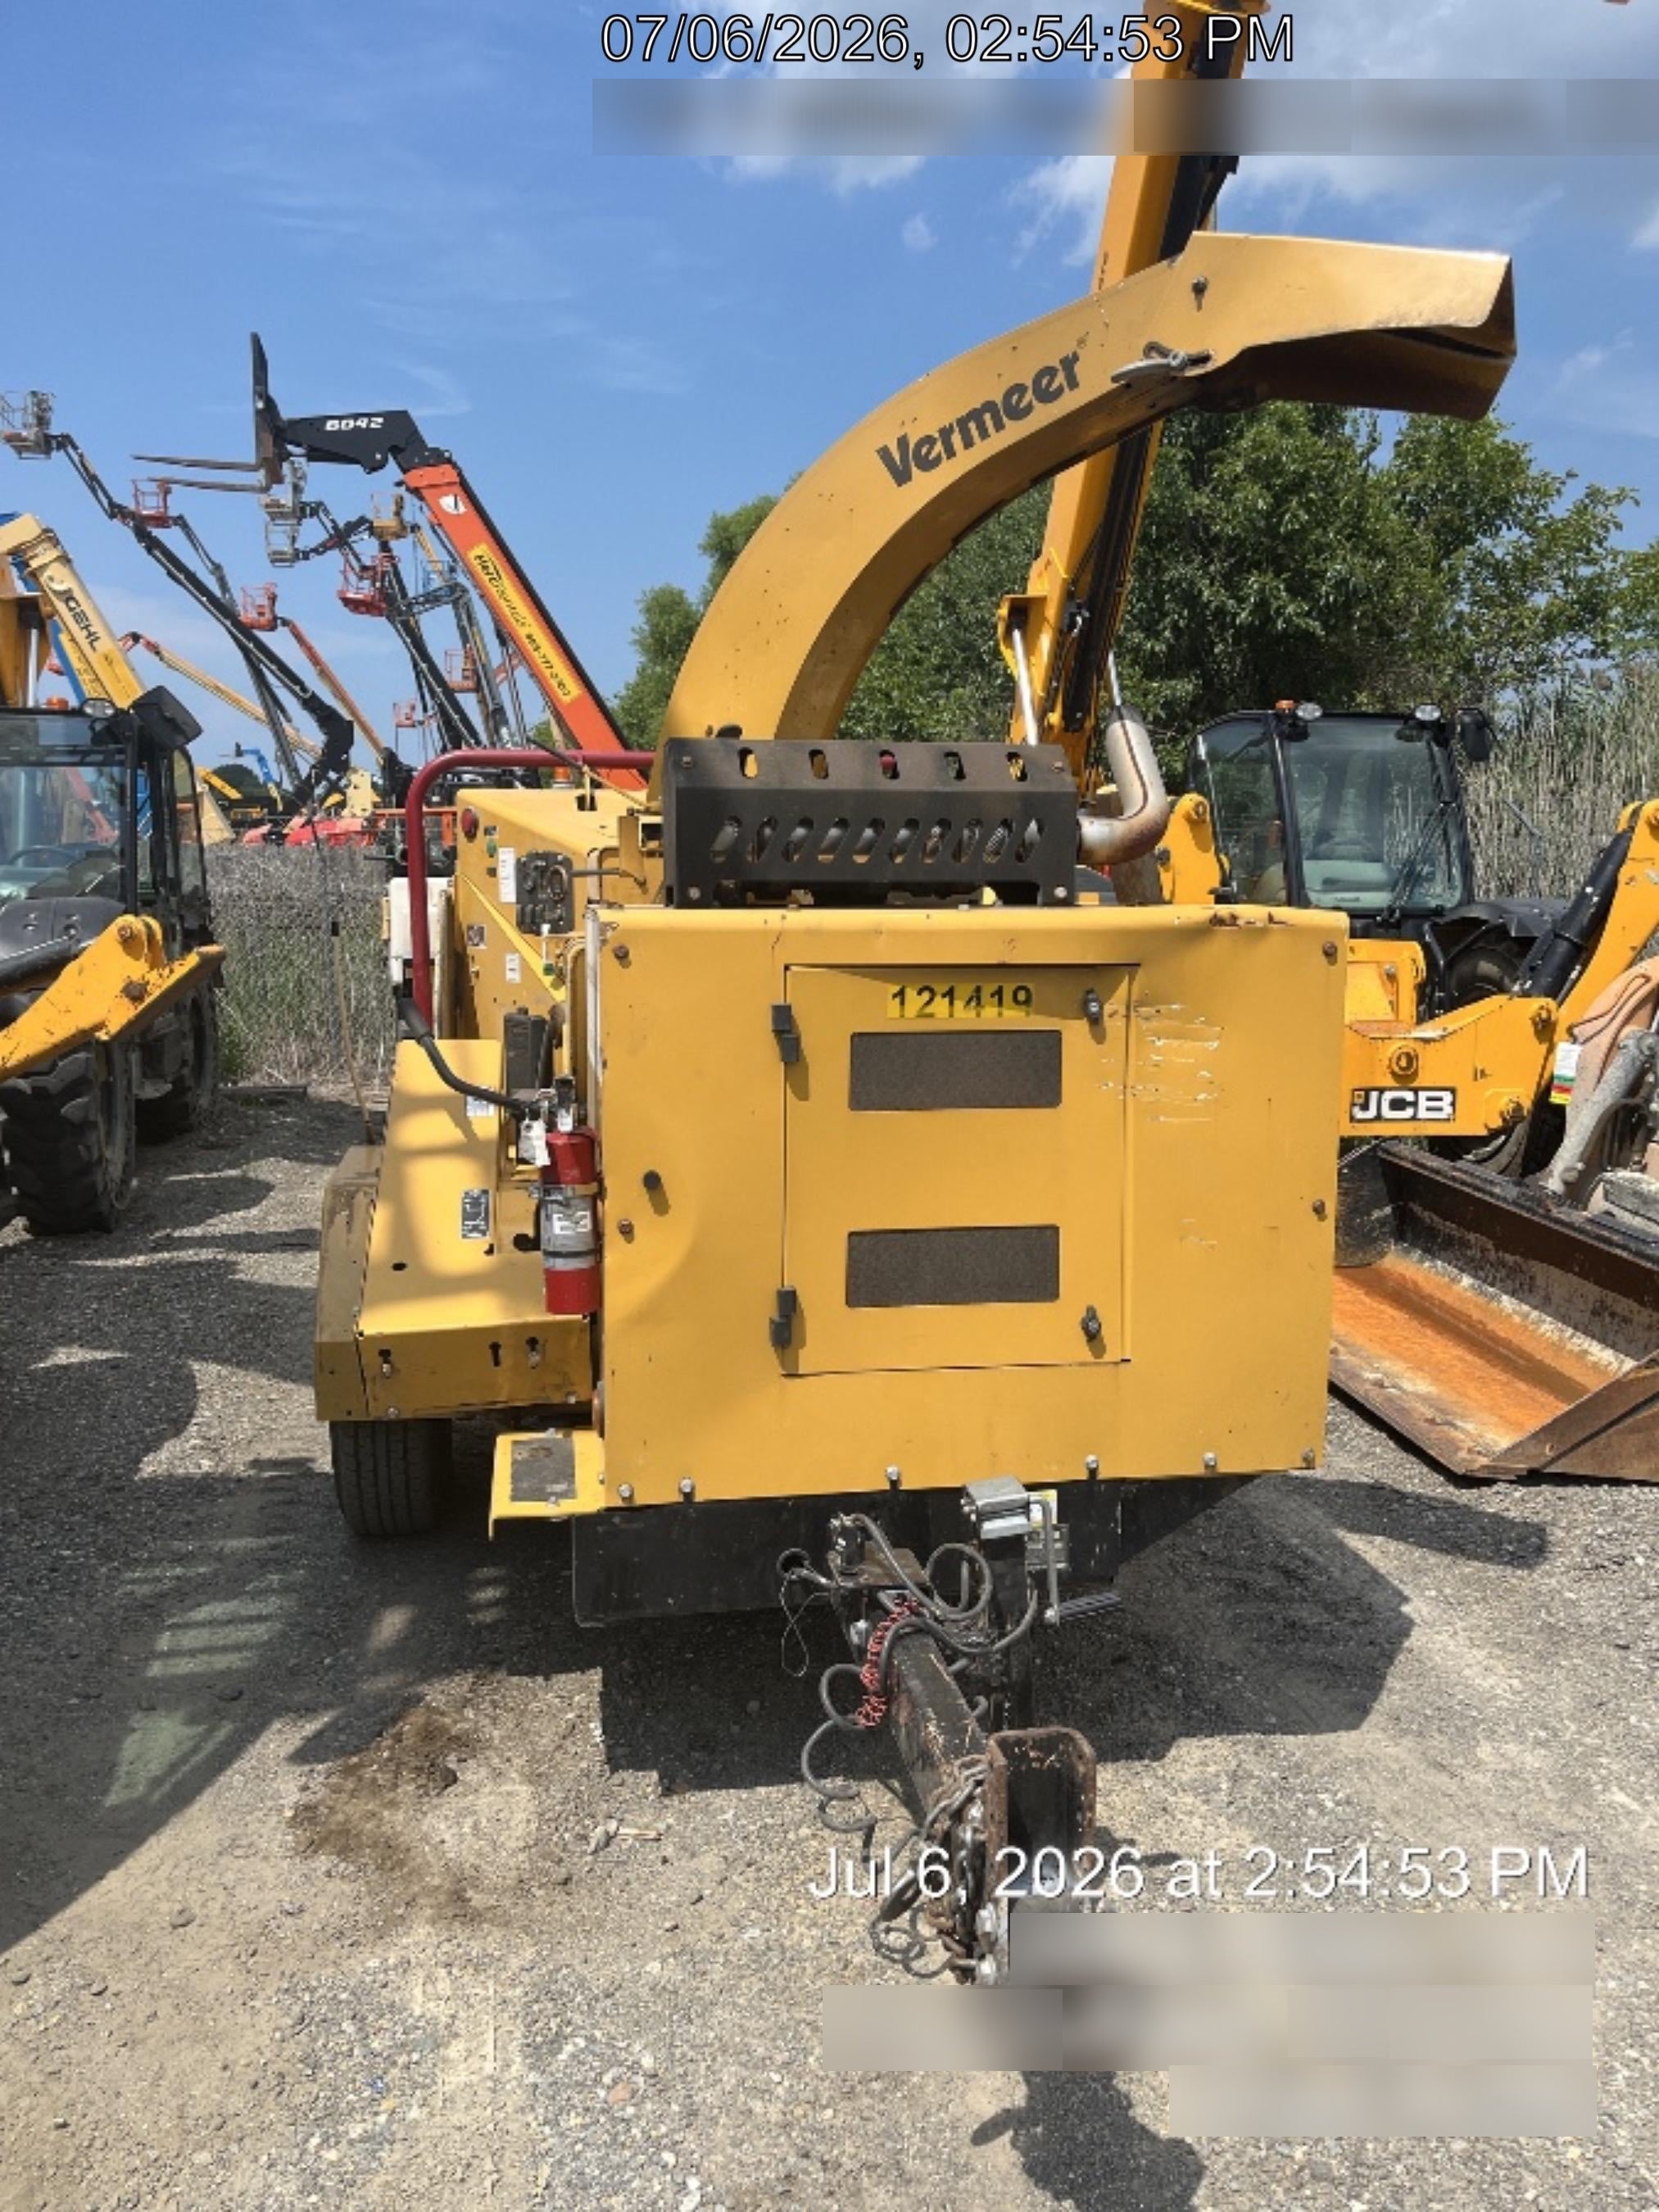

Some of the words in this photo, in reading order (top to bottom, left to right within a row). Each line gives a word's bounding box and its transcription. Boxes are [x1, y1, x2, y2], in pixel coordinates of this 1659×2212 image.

[325, 417, 384, 431] 6042
[875, 351, 1080, 487] Vermeer
[65, 596, 101, 652] GEHL
[891, 985, 1033, 1018] 121419
[1352, 1090, 1454, 1119] JCB
